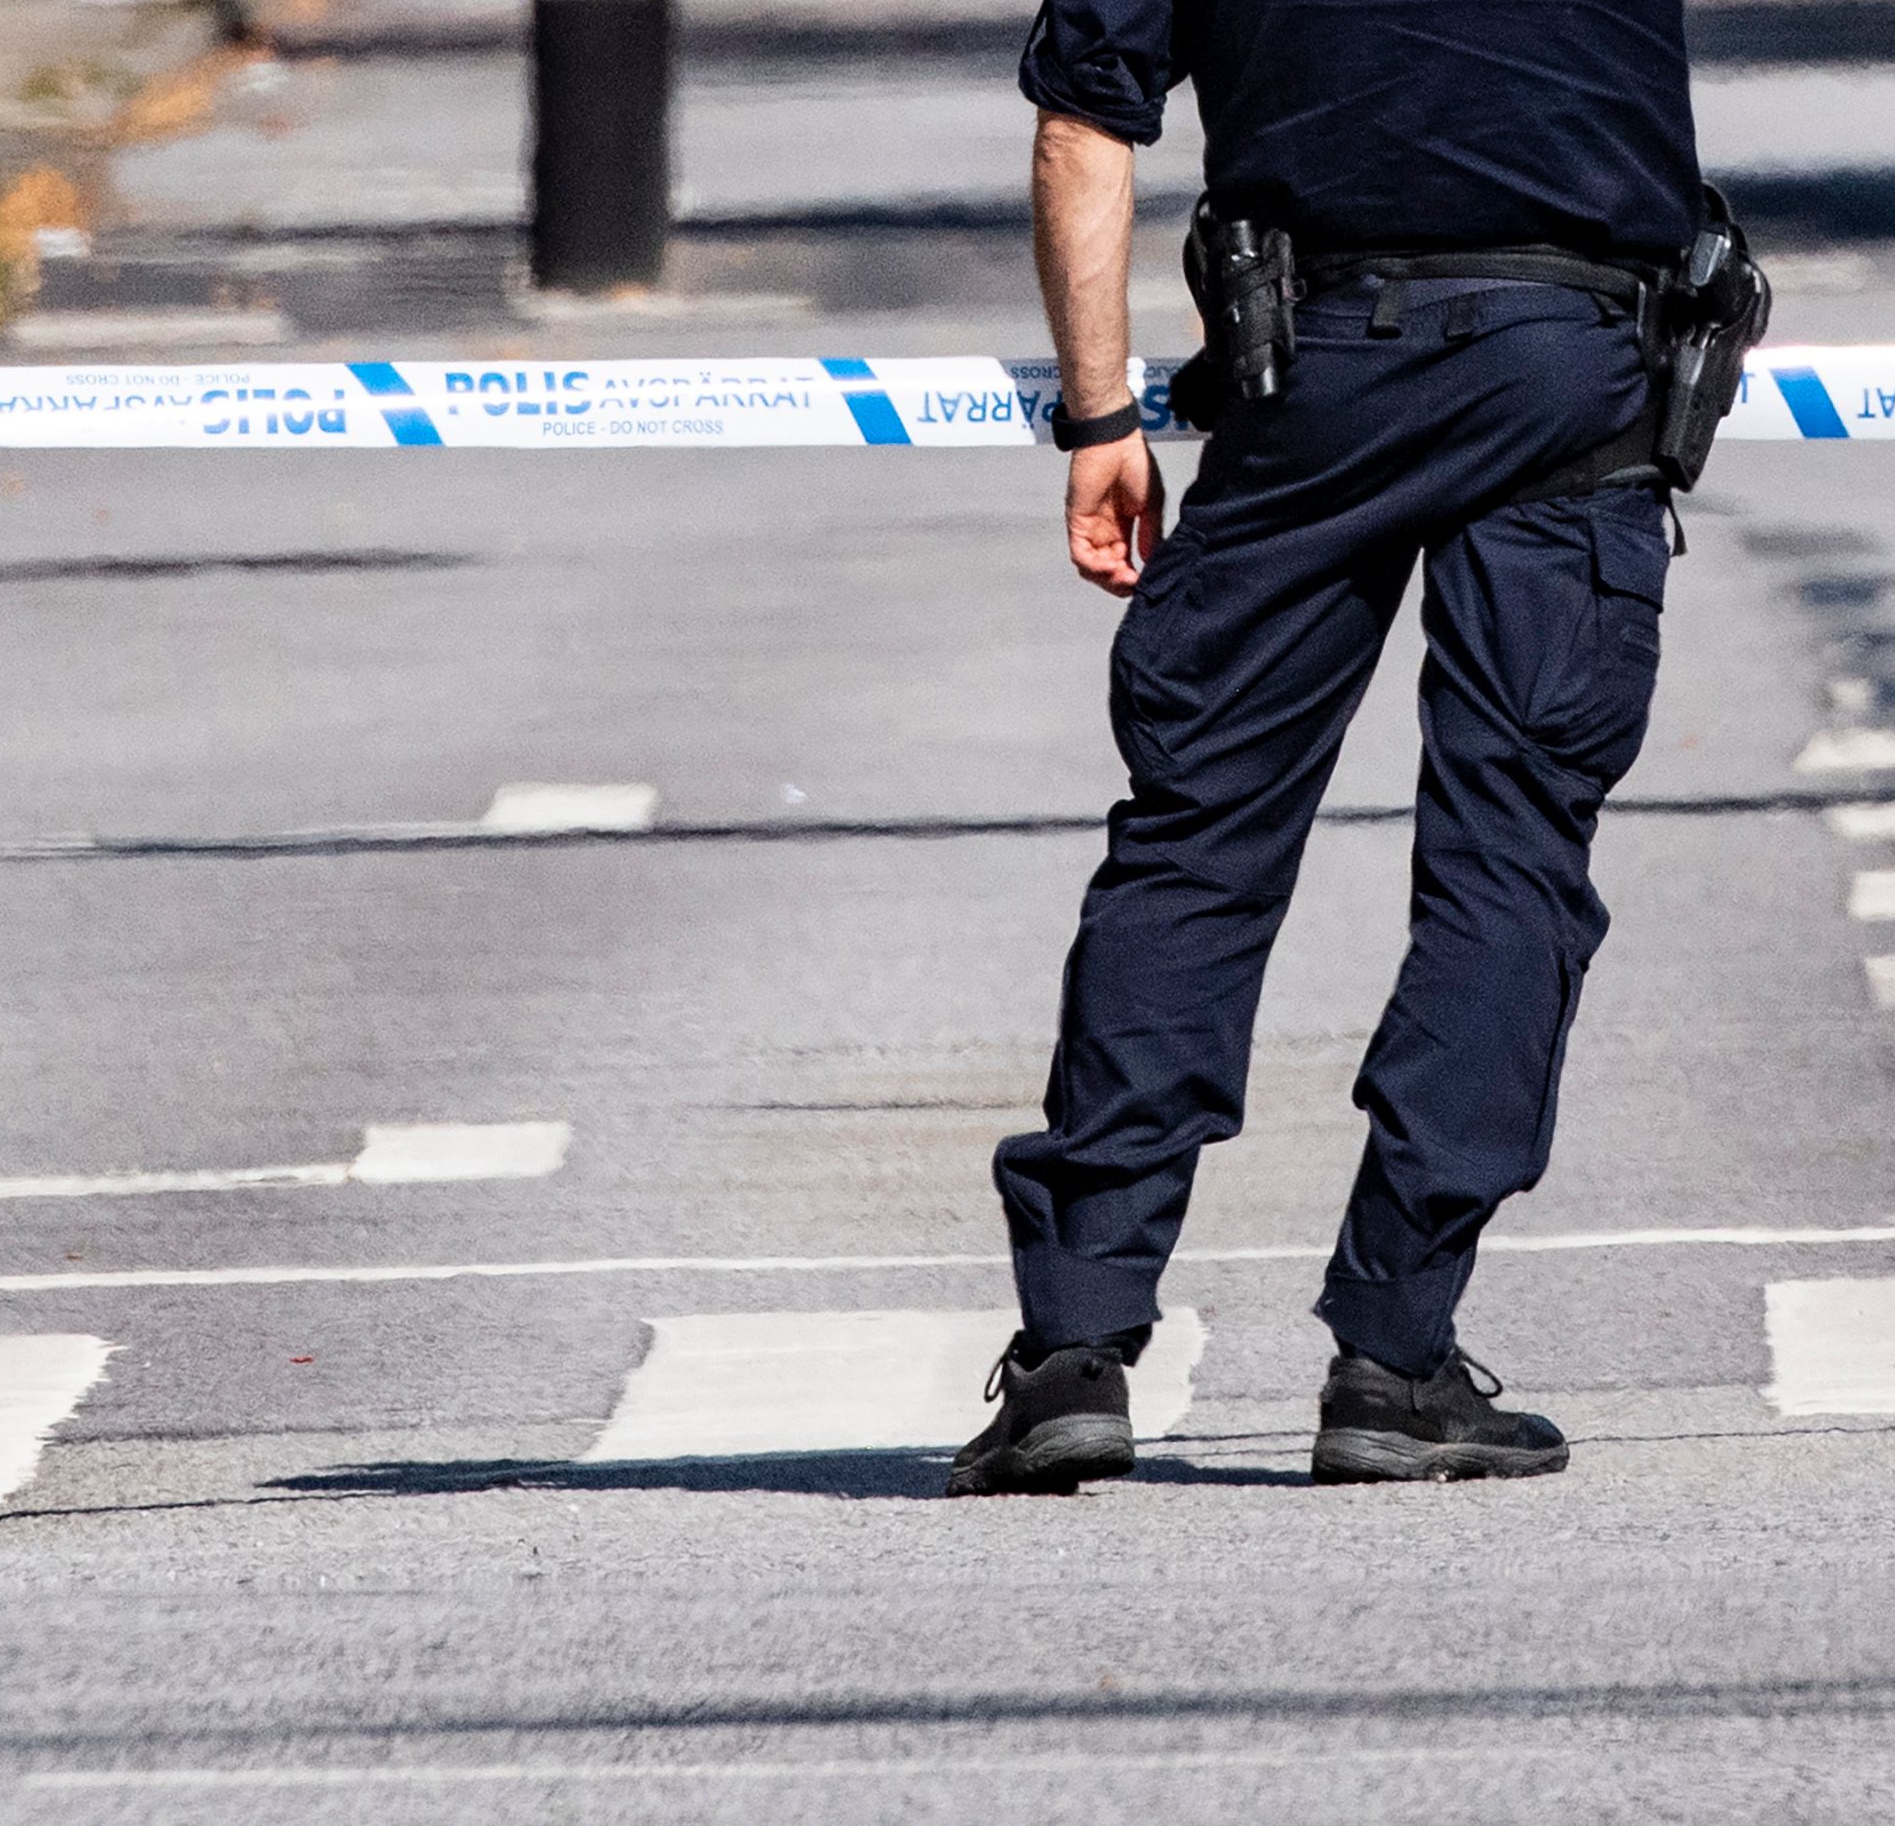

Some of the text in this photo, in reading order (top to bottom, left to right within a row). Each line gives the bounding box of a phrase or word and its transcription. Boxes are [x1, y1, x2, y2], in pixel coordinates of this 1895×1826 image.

[65, 374, 119, 385] CROSS
[125, 374, 157, 384] NOT
[159, 374, 180, 384] DO
[193, 374, 250, 384] POLICE
[445, 371, 592, 416] POLIS
[200, 388, 347, 434] POLIS
[917, 390, 1062, 429] PÄRRAT
[542, 420, 595, 435] POLICE
[610, 420, 634, 435] DO
[636, 420, 667, 434] NOT
[672, 419, 724, 434] CROSS
